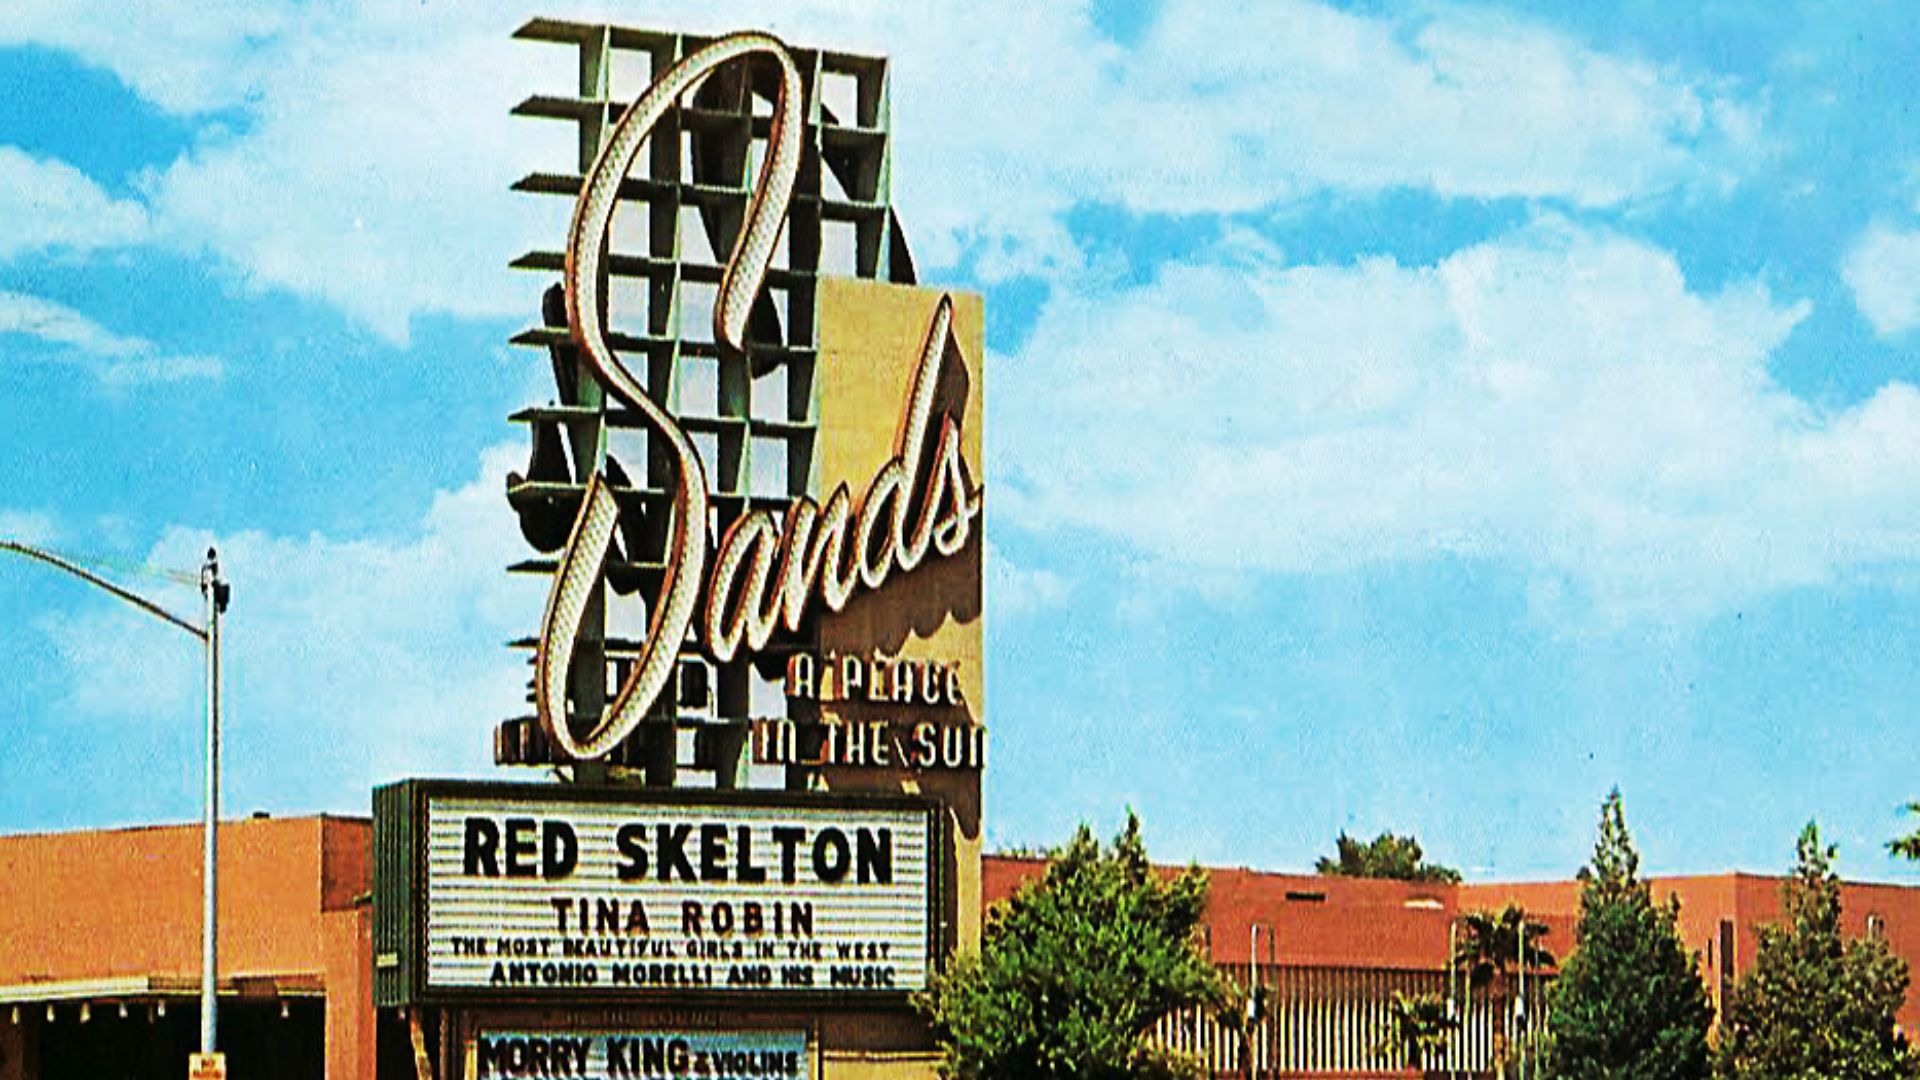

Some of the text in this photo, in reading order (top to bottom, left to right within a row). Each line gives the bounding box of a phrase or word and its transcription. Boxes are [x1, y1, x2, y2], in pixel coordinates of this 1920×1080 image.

[537, 31, 984, 760] Sands
[787, 653, 962, 705] A PLACE
[825, 717, 889, 765] THE
[464, 817, 893, 884] RED SKELTON
[552, 897, 814, 937] TINA ROBIN
[450, 936, 891, 961] THE MOST BEAUTIFUL GIRLS IN THE WEST
[490, 962, 896, 986] ANTONIO MORELLI AND HIS MUSIC
[478, 1037, 798, 1077] MORRY KING & VIOLINS
